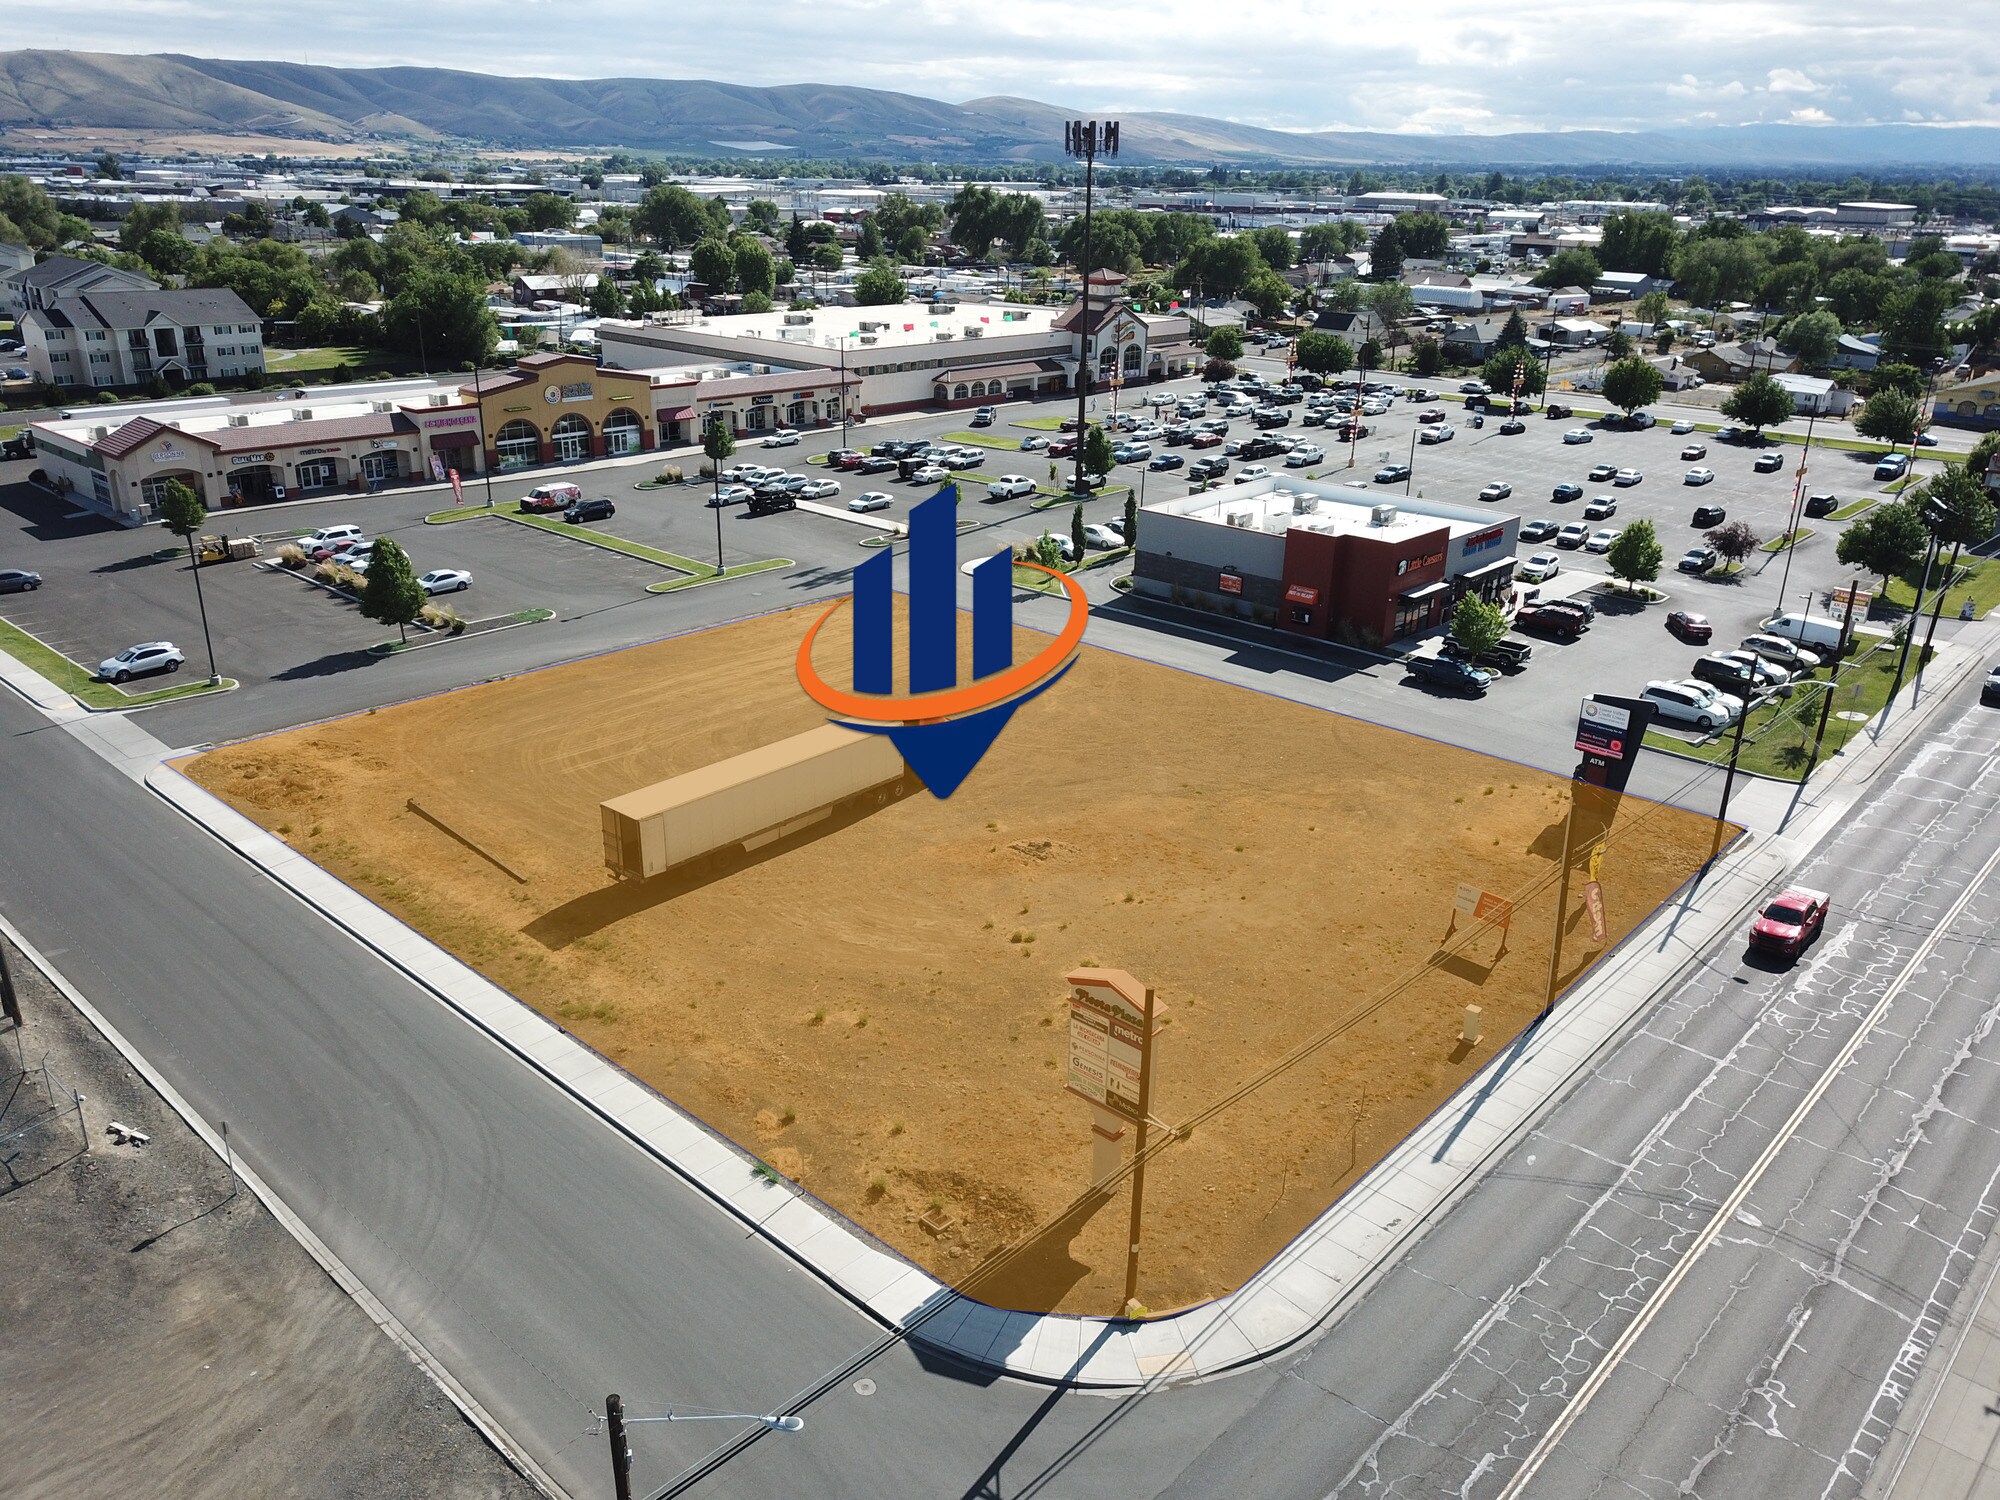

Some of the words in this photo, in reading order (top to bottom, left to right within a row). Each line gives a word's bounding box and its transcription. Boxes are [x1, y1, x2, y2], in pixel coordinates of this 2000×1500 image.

[1407, 556, 1422, 572] Little
[1422, 552, 1444, 567] Caesars
[1590, 757, 1605, 767] ATM
[1111, 1004, 1144, 1028] Plaza
